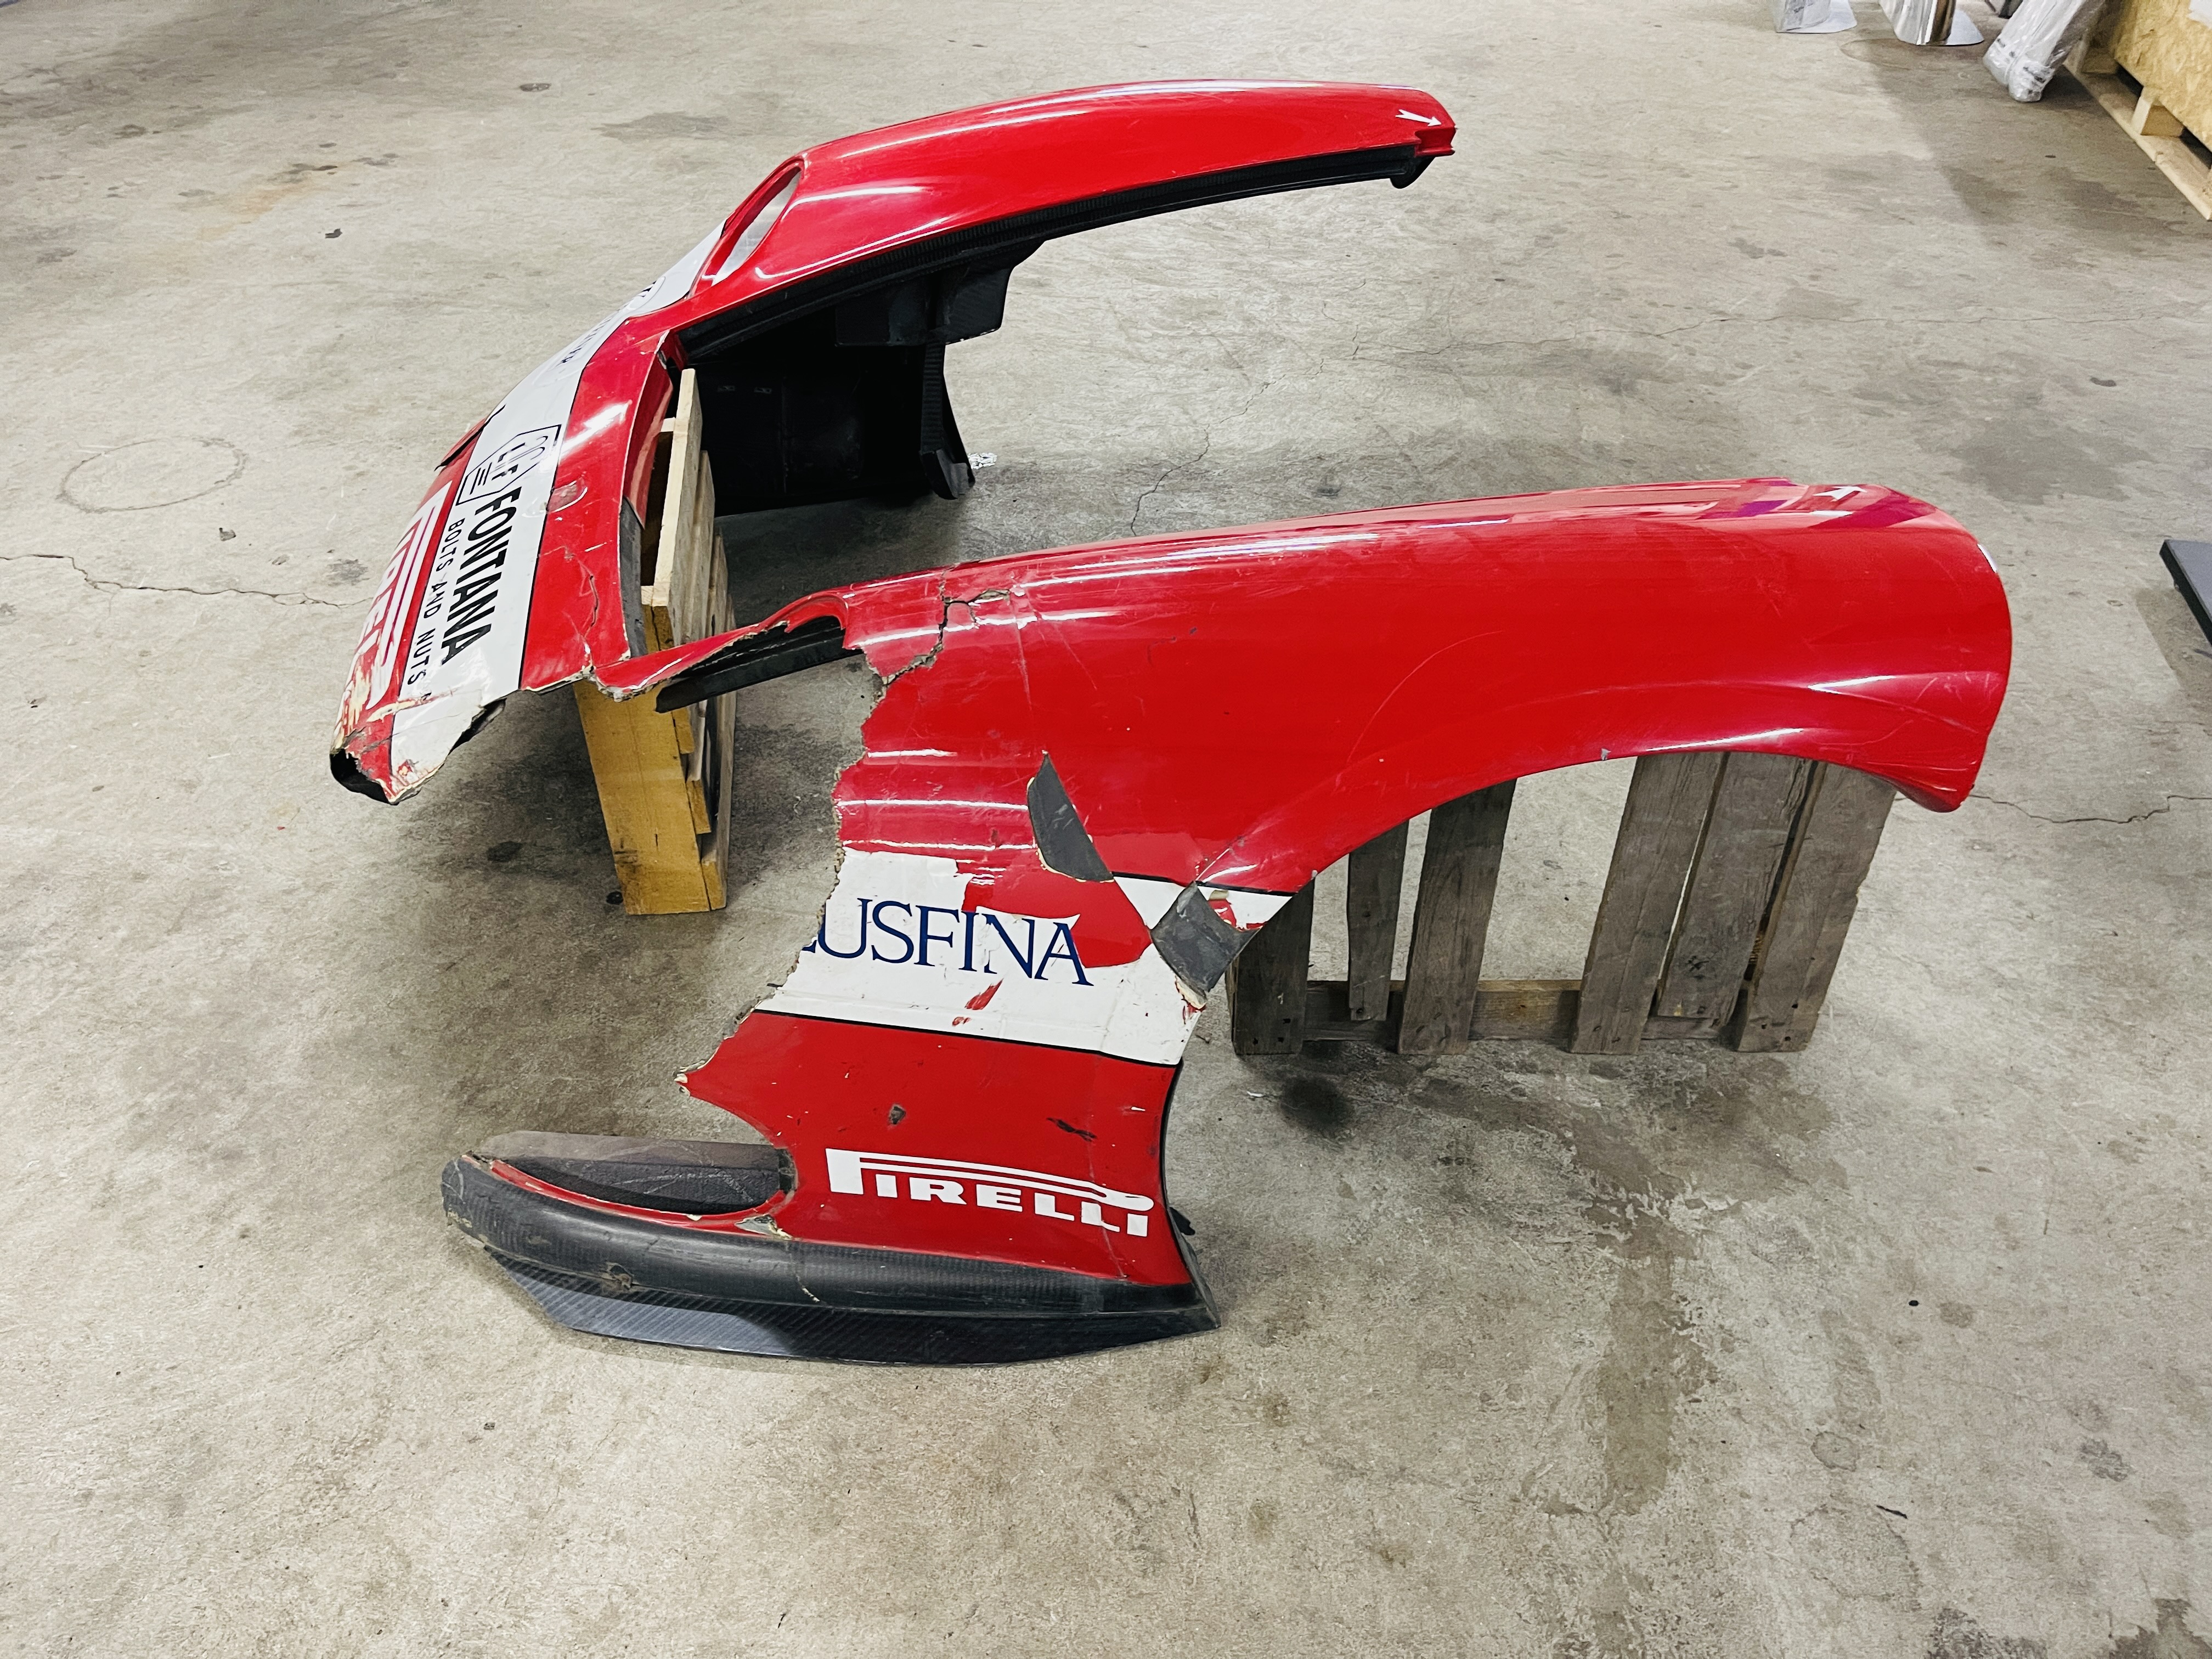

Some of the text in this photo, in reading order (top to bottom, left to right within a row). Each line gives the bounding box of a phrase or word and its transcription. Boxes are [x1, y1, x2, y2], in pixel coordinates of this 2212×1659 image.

[407, 517, 466, 685] BOLTS AND NUTS
[441, 486, 522, 665] FONTANA
[802, 898, 1094, 986] USFINA
[825, 1148, 1154, 1238] PIRELLI
